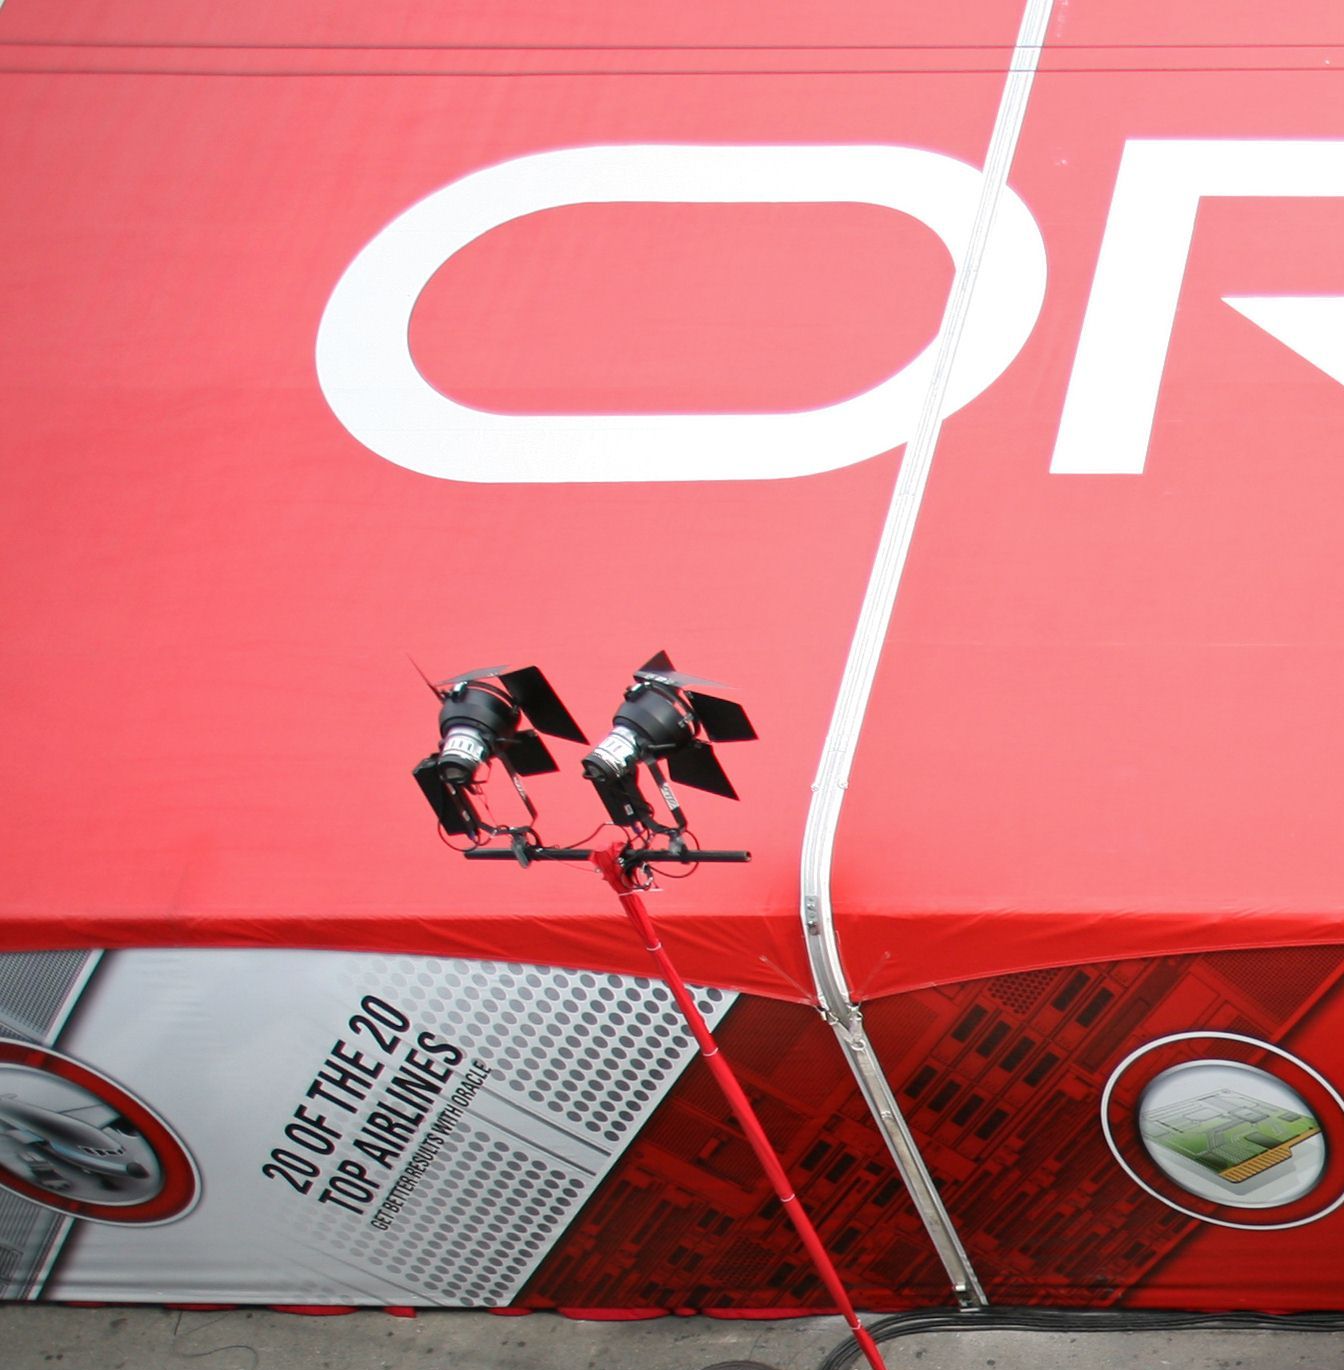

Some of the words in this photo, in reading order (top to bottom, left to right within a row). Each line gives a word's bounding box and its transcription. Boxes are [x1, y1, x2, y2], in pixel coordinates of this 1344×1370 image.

[349, 995, 411, 1055] 20
[306, 1039, 385, 1114] THE
[284, 1103, 342, 1156] OF
[318, 1159, 381, 1215] TOP
[352, 1031, 463, 1170] AIRLINES
[370, 1209, 394, 1231] GET
[382, 1175, 418, 1213] BETTER
[405, 1133, 444, 1179] RESULTS
[431, 1103, 464, 1136] WITH
[451, 1060, 492, 1107] ORACLE
[261, 1148, 320, 1195] 20
